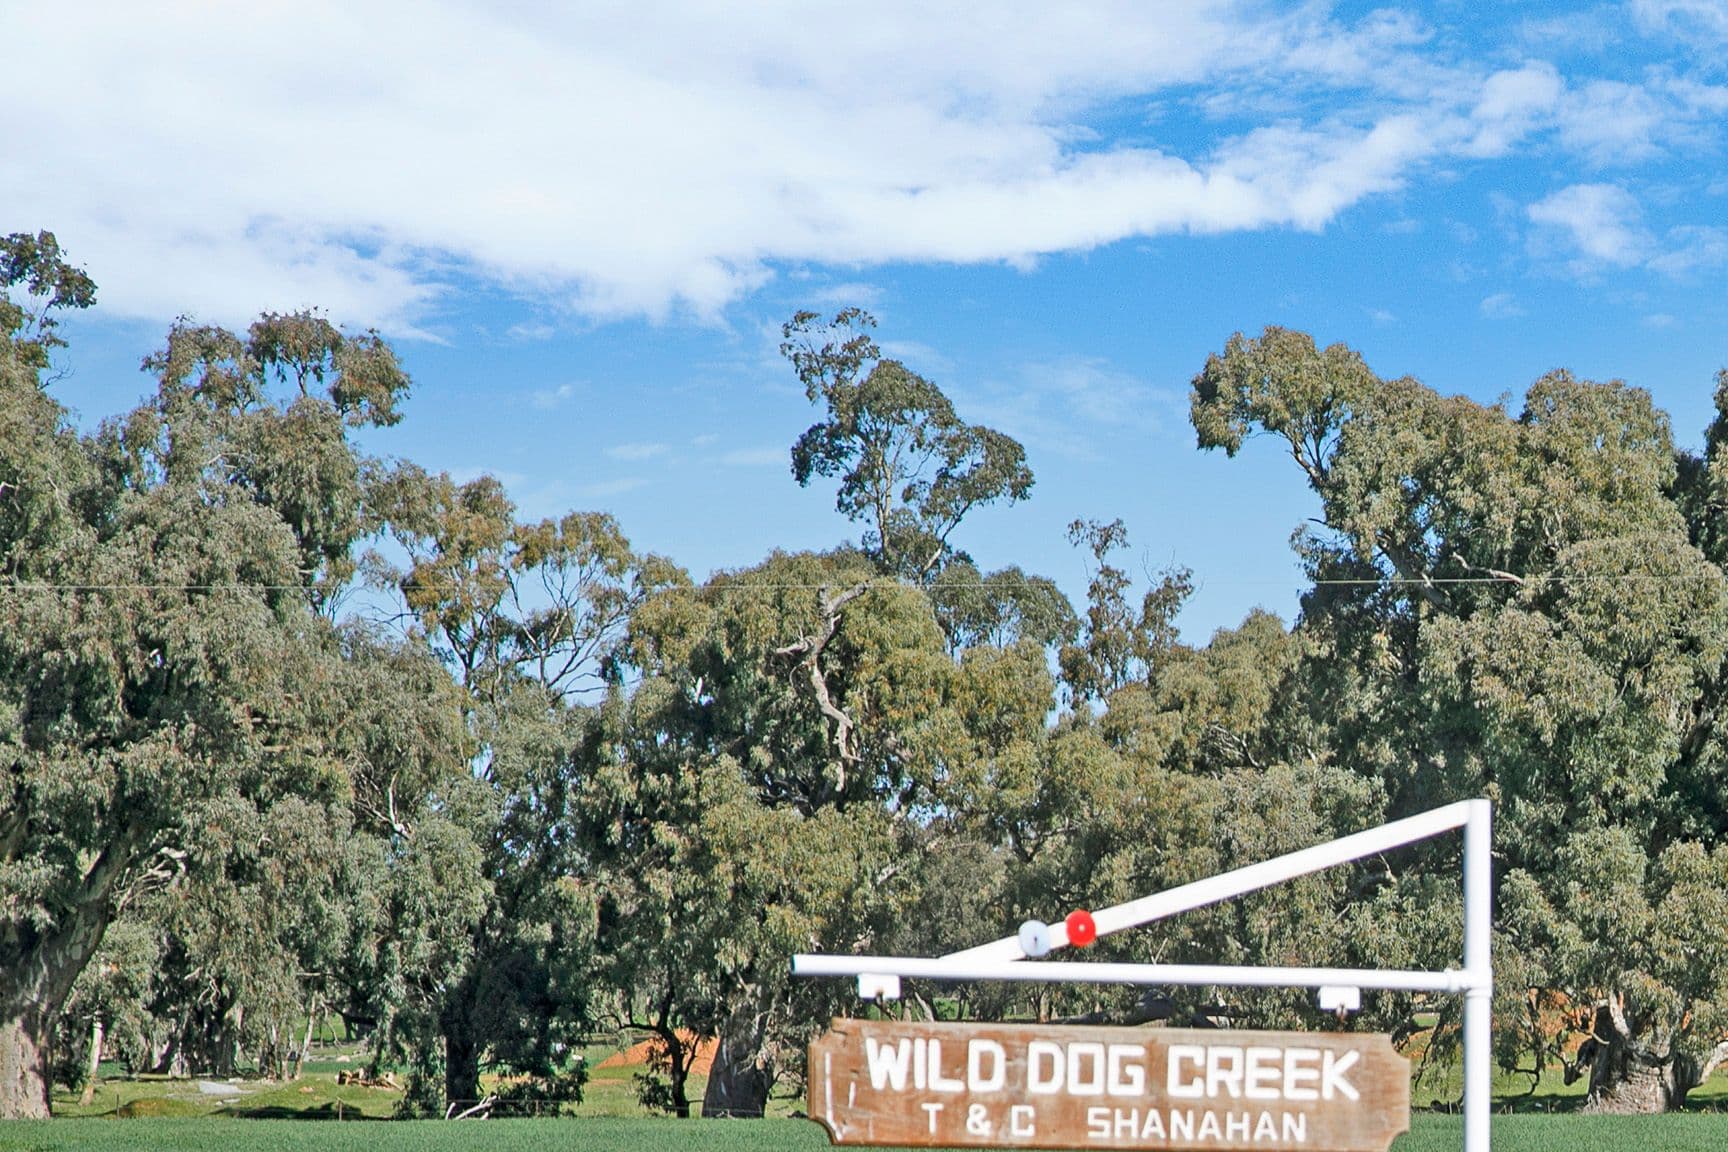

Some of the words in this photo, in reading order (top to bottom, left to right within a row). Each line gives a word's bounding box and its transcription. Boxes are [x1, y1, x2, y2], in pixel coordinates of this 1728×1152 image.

[864, 1036, 1004, 1093] WILD
[1027, 1040, 1146, 1097] DOG
[1166, 1045, 1361, 1101] CREEK
[920, 1102, 945, 1135] T
[965, 1104, 993, 1138] &
[1010, 1105, 1036, 1138] C
[1087, 1107, 1307, 1143] SHANAHAN
